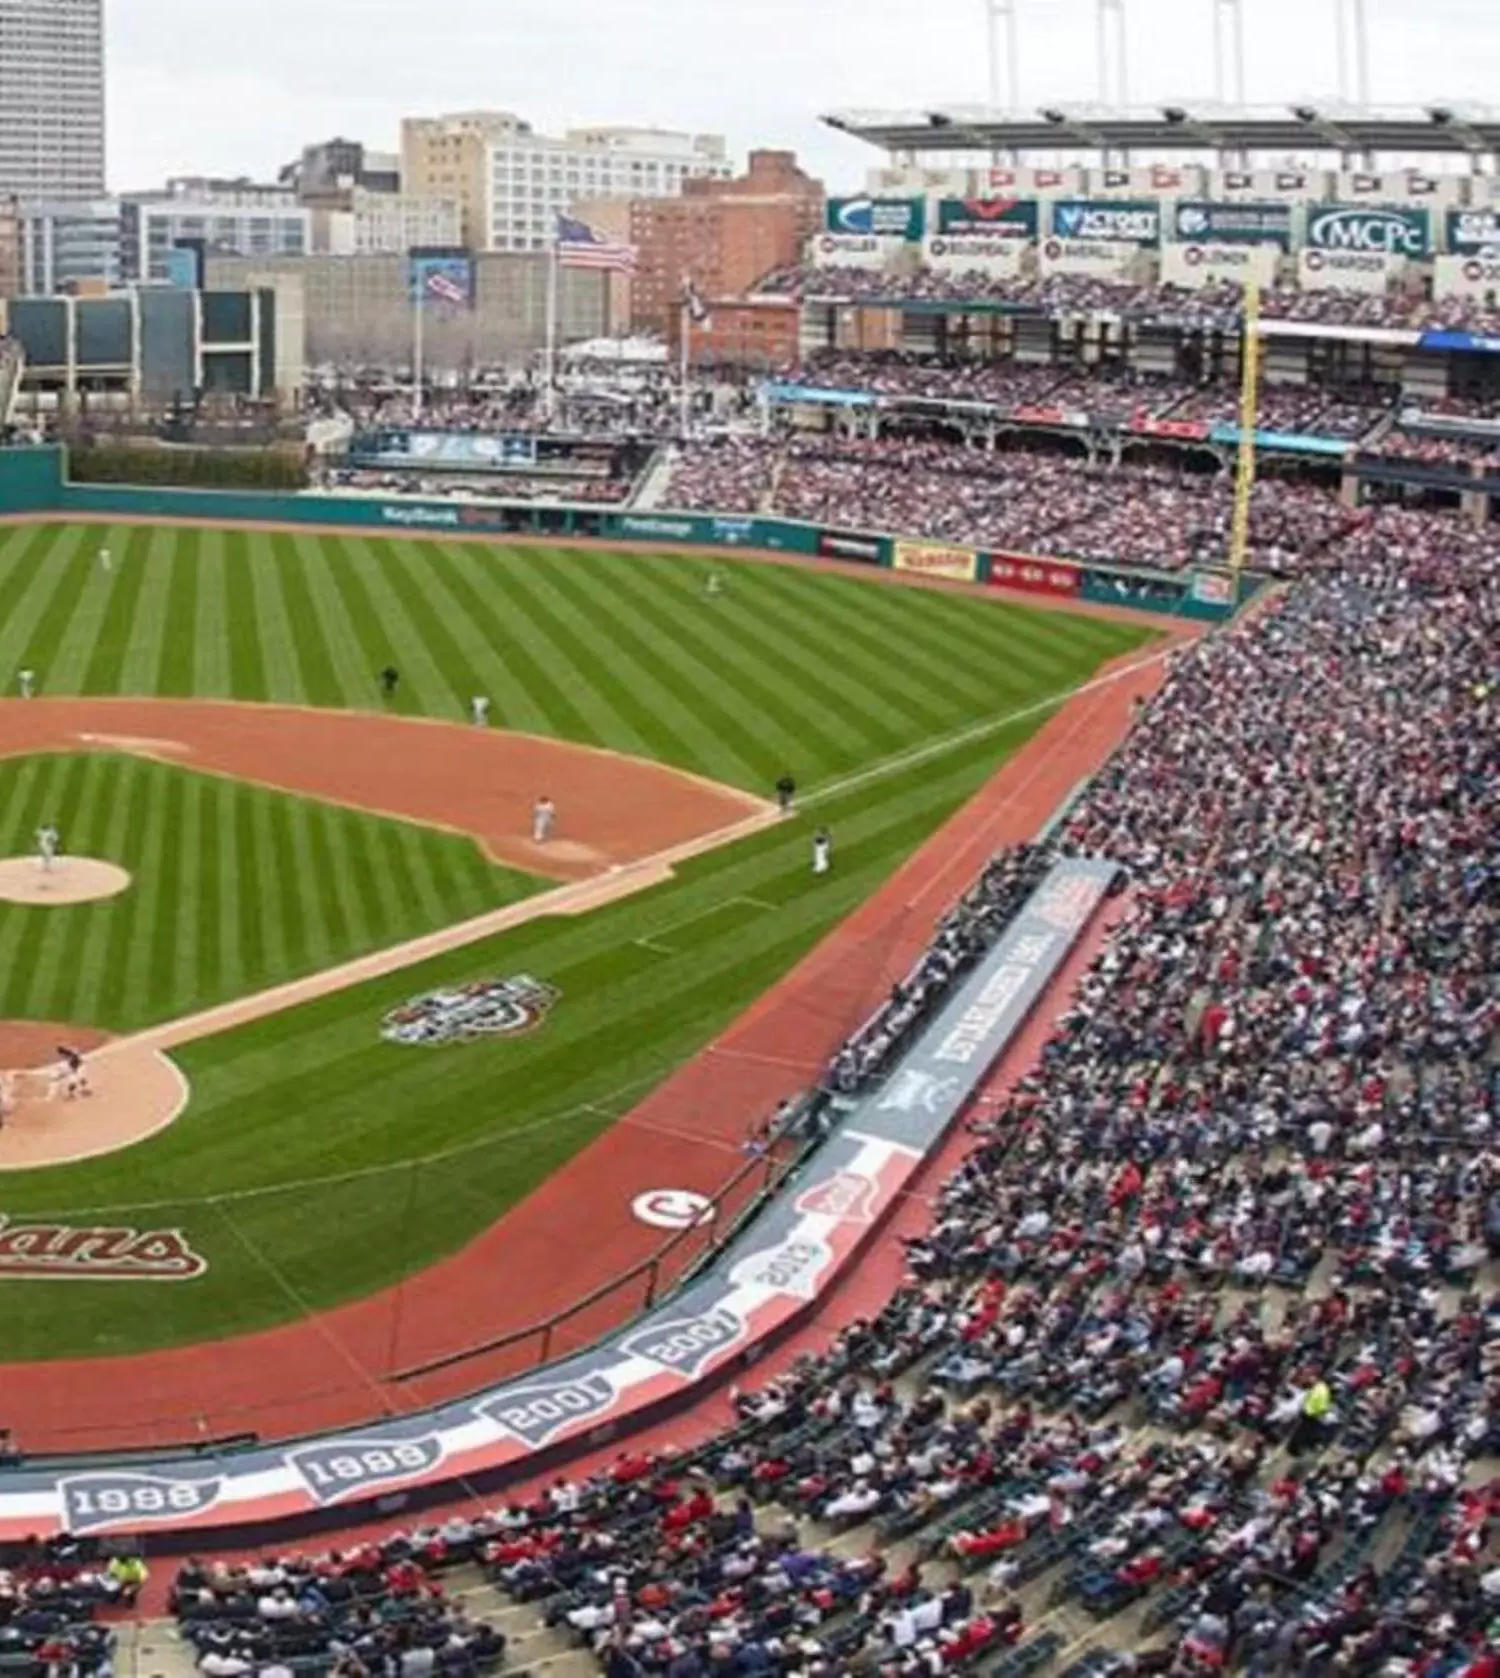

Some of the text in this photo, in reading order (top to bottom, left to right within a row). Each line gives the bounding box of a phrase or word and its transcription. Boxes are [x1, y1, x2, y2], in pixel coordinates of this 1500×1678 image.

[1328, 220, 1422, 250] MCPc
[647, 1309, 739, 1363] 2007
[501, 1375, 608, 1430] 2001
[73, 1485, 200, 1514] 1998
